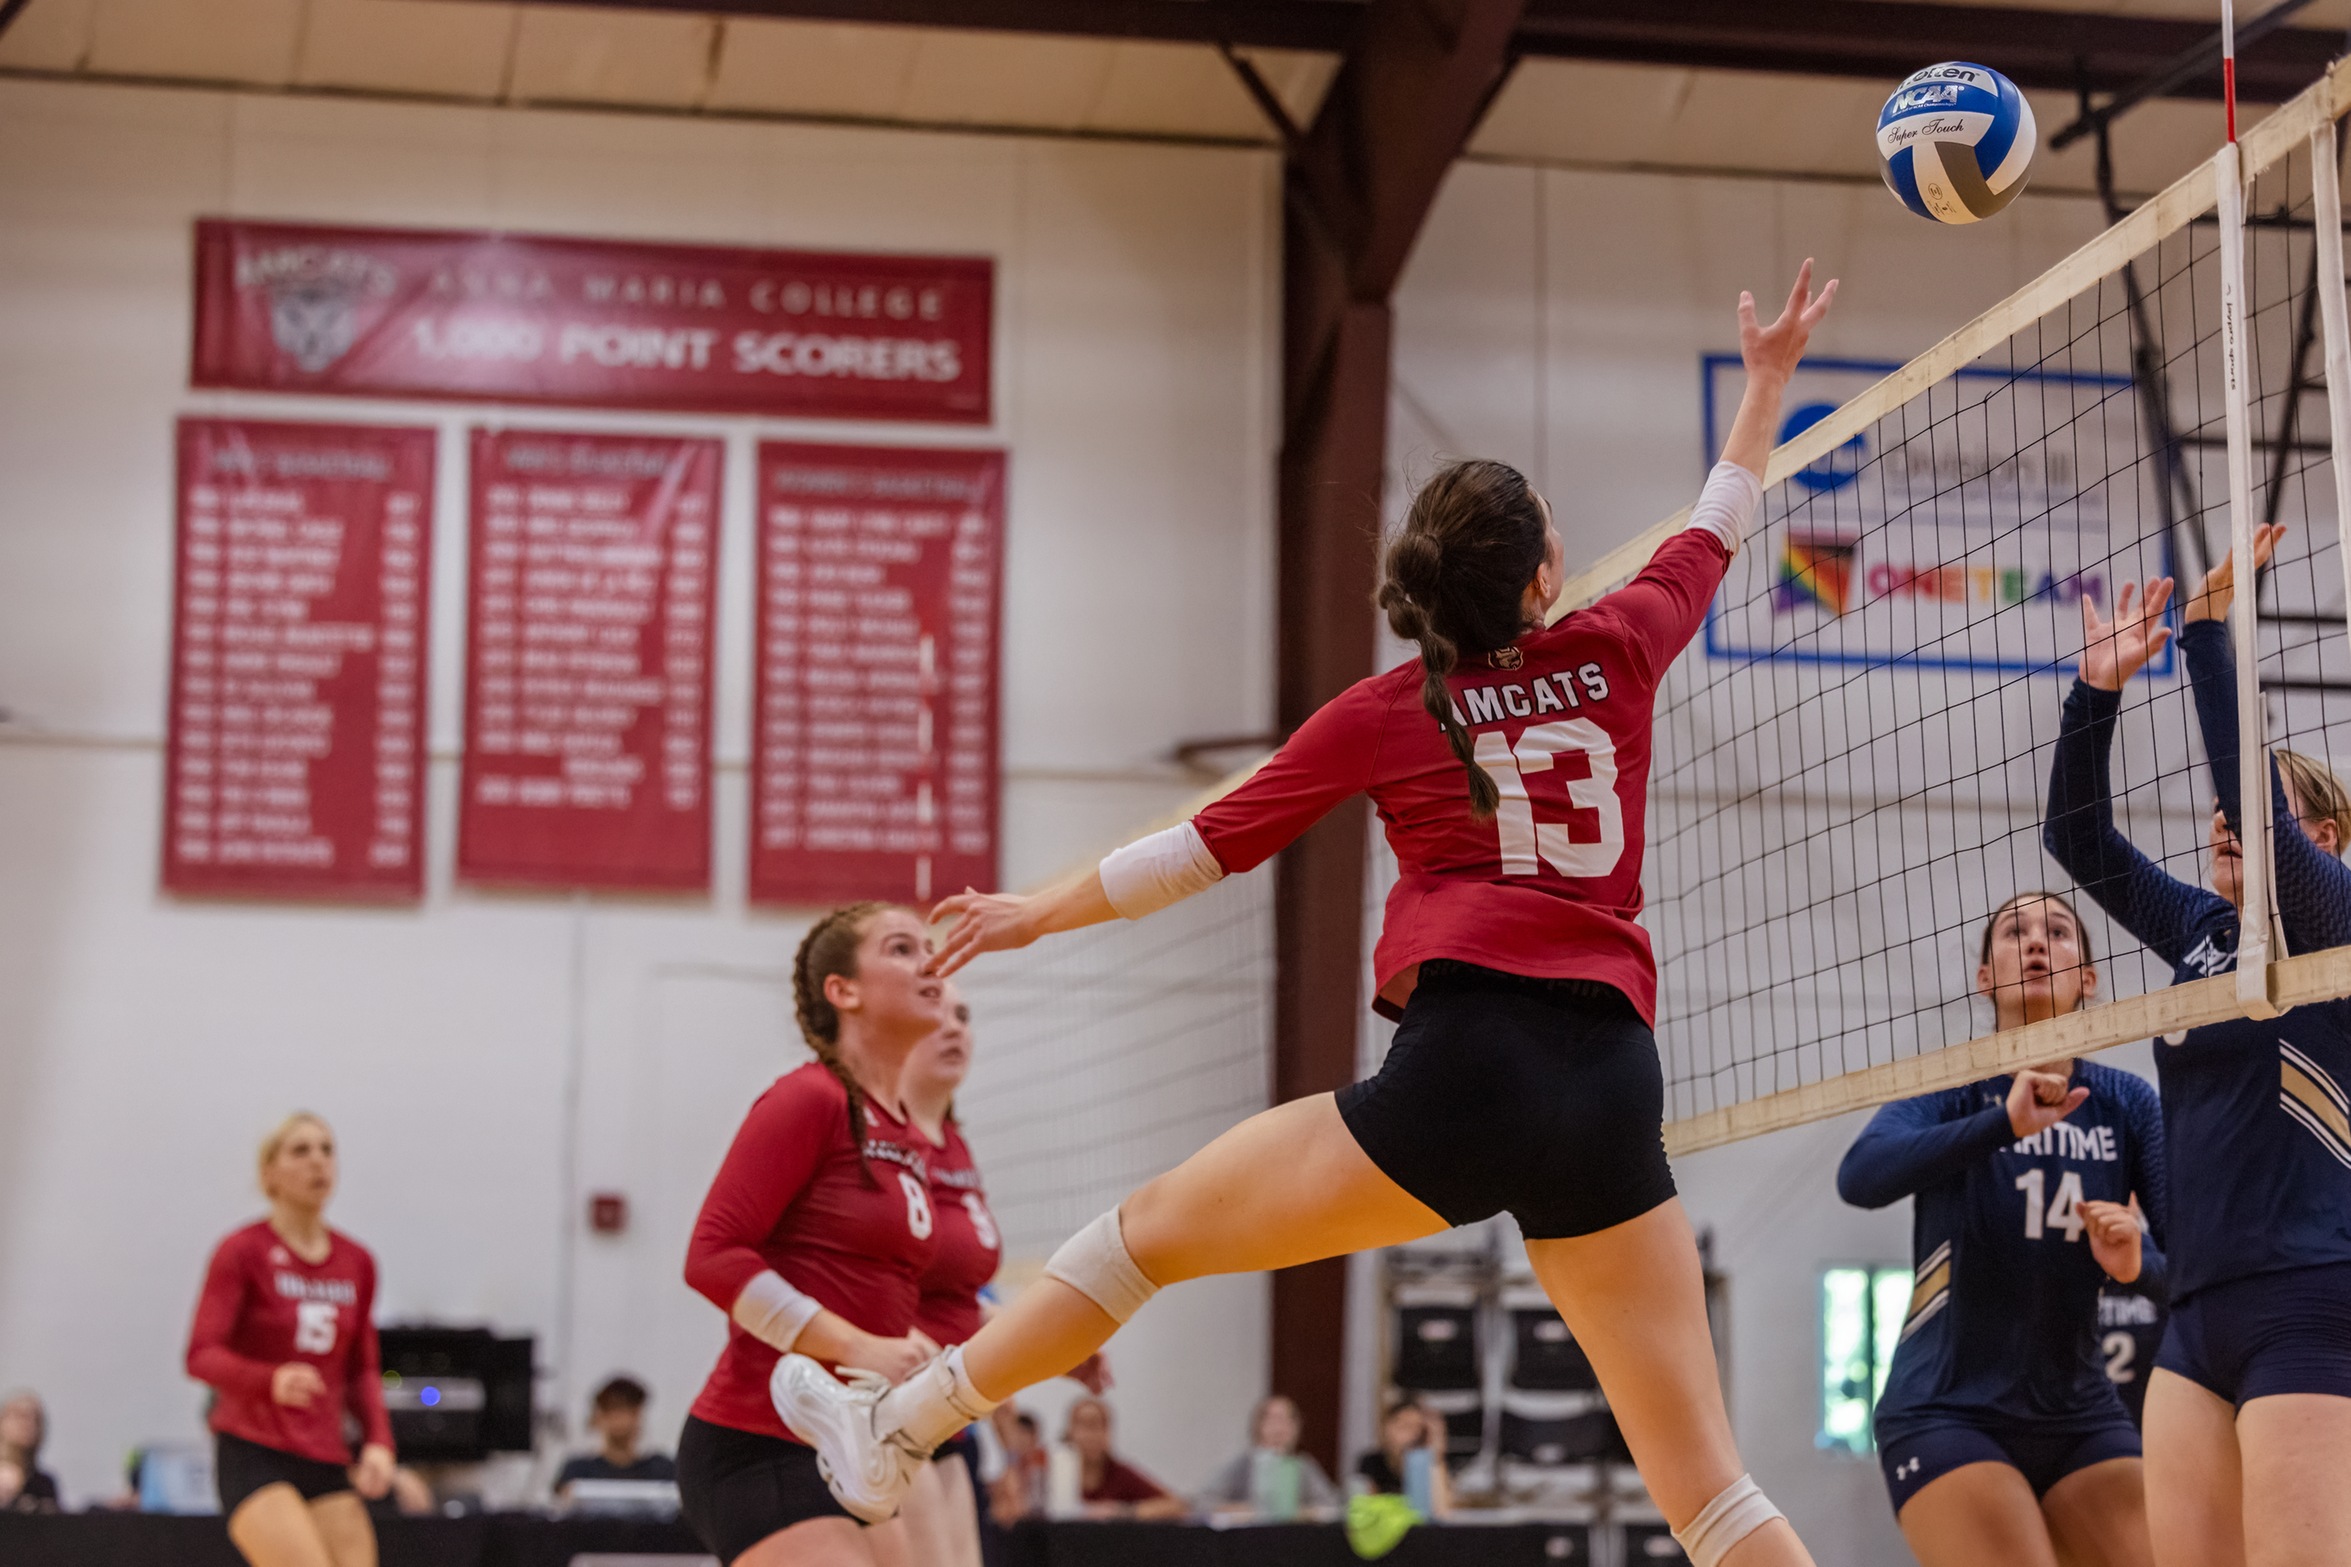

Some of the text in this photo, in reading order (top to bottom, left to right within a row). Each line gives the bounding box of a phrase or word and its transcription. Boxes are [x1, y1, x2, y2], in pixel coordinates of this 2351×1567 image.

[1892, 85, 1959, 114] NCAA
[1887, 118, 1964, 145] Super Touch
[749, 278, 943, 323] COLLEGE
[560, 320, 719, 371] POINT
[732, 329, 963, 383] SCORERS
[1473, 717, 1625, 877] 13
[1999, 1121, 2119, 1162] RITIME
[898, 1171, 933, 1241] 8
[2015, 1168, 2086, 1242] 14
